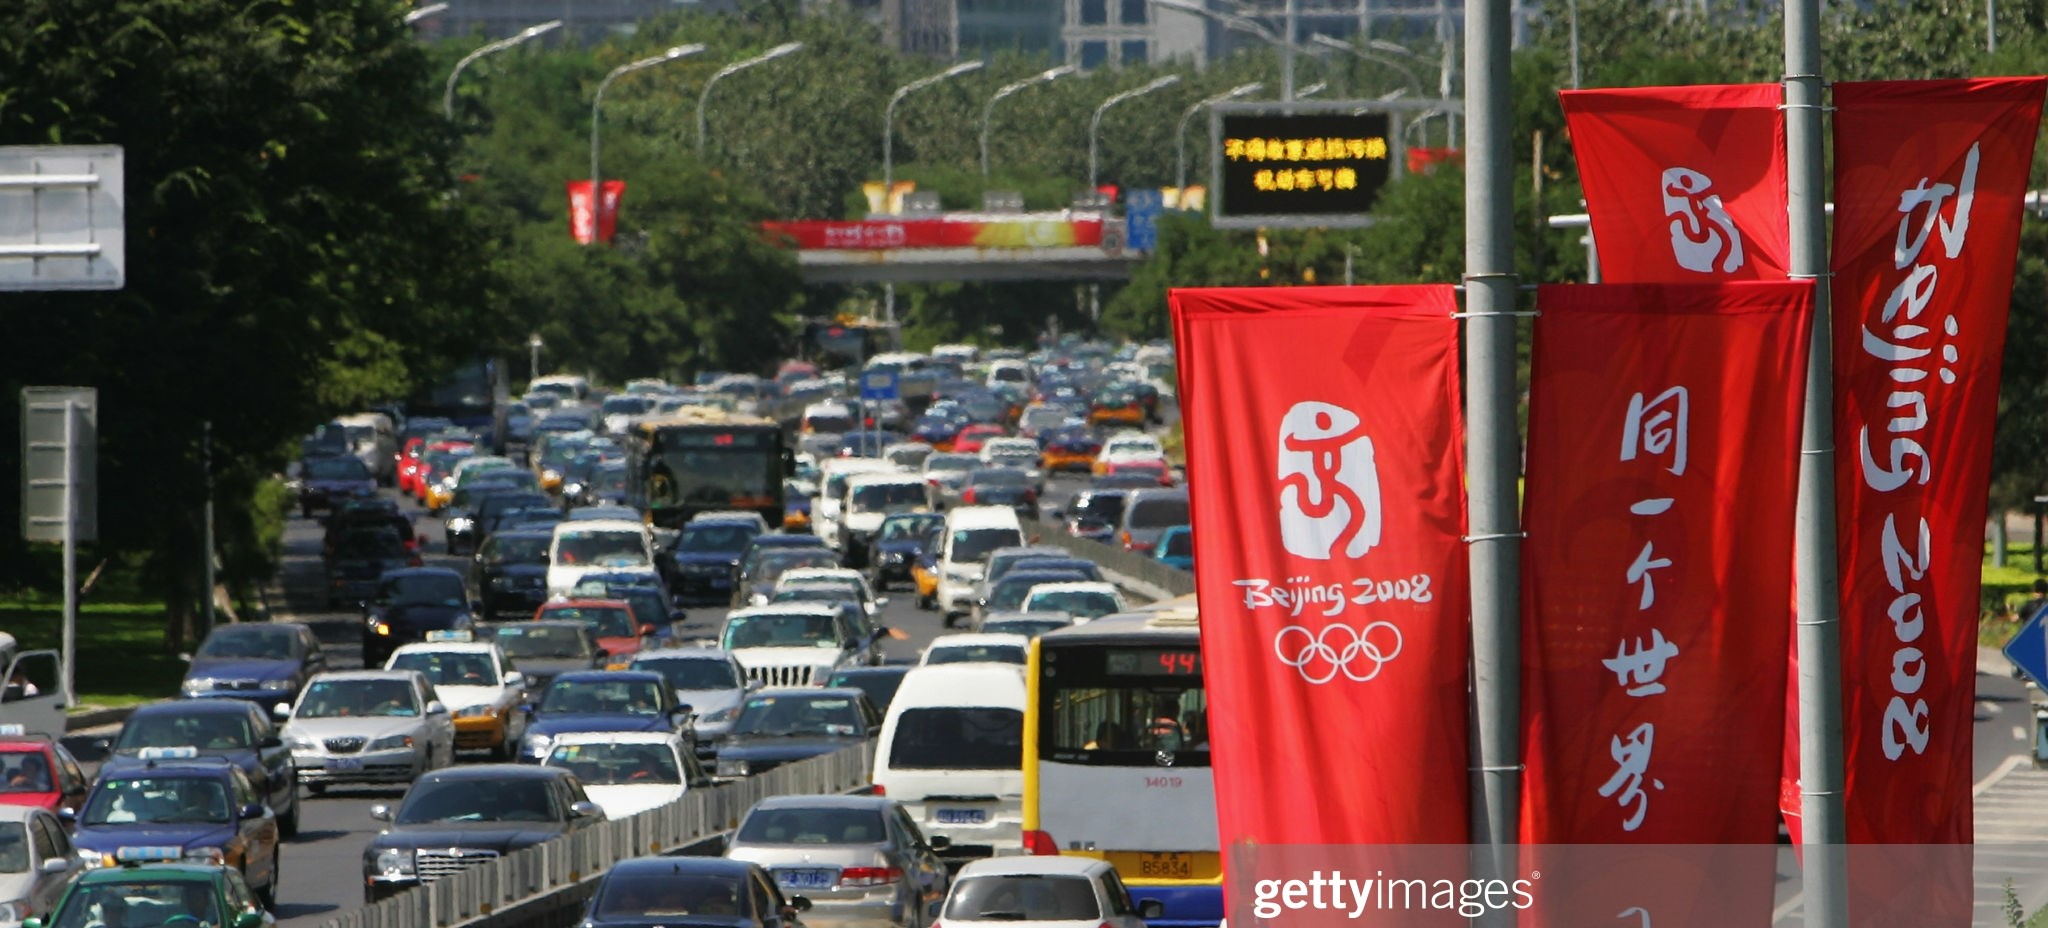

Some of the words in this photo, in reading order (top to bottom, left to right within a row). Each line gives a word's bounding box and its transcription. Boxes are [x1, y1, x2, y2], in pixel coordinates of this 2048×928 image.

[1859, 144, 1980, 492] Beijing
[1231, 575, 1346, 617] Beijing
[1350, 573, 1433, 606] 2008
[1598, 385, 1688, 831] 同一个世界
[1881, 513, 1931, 761] 2008
